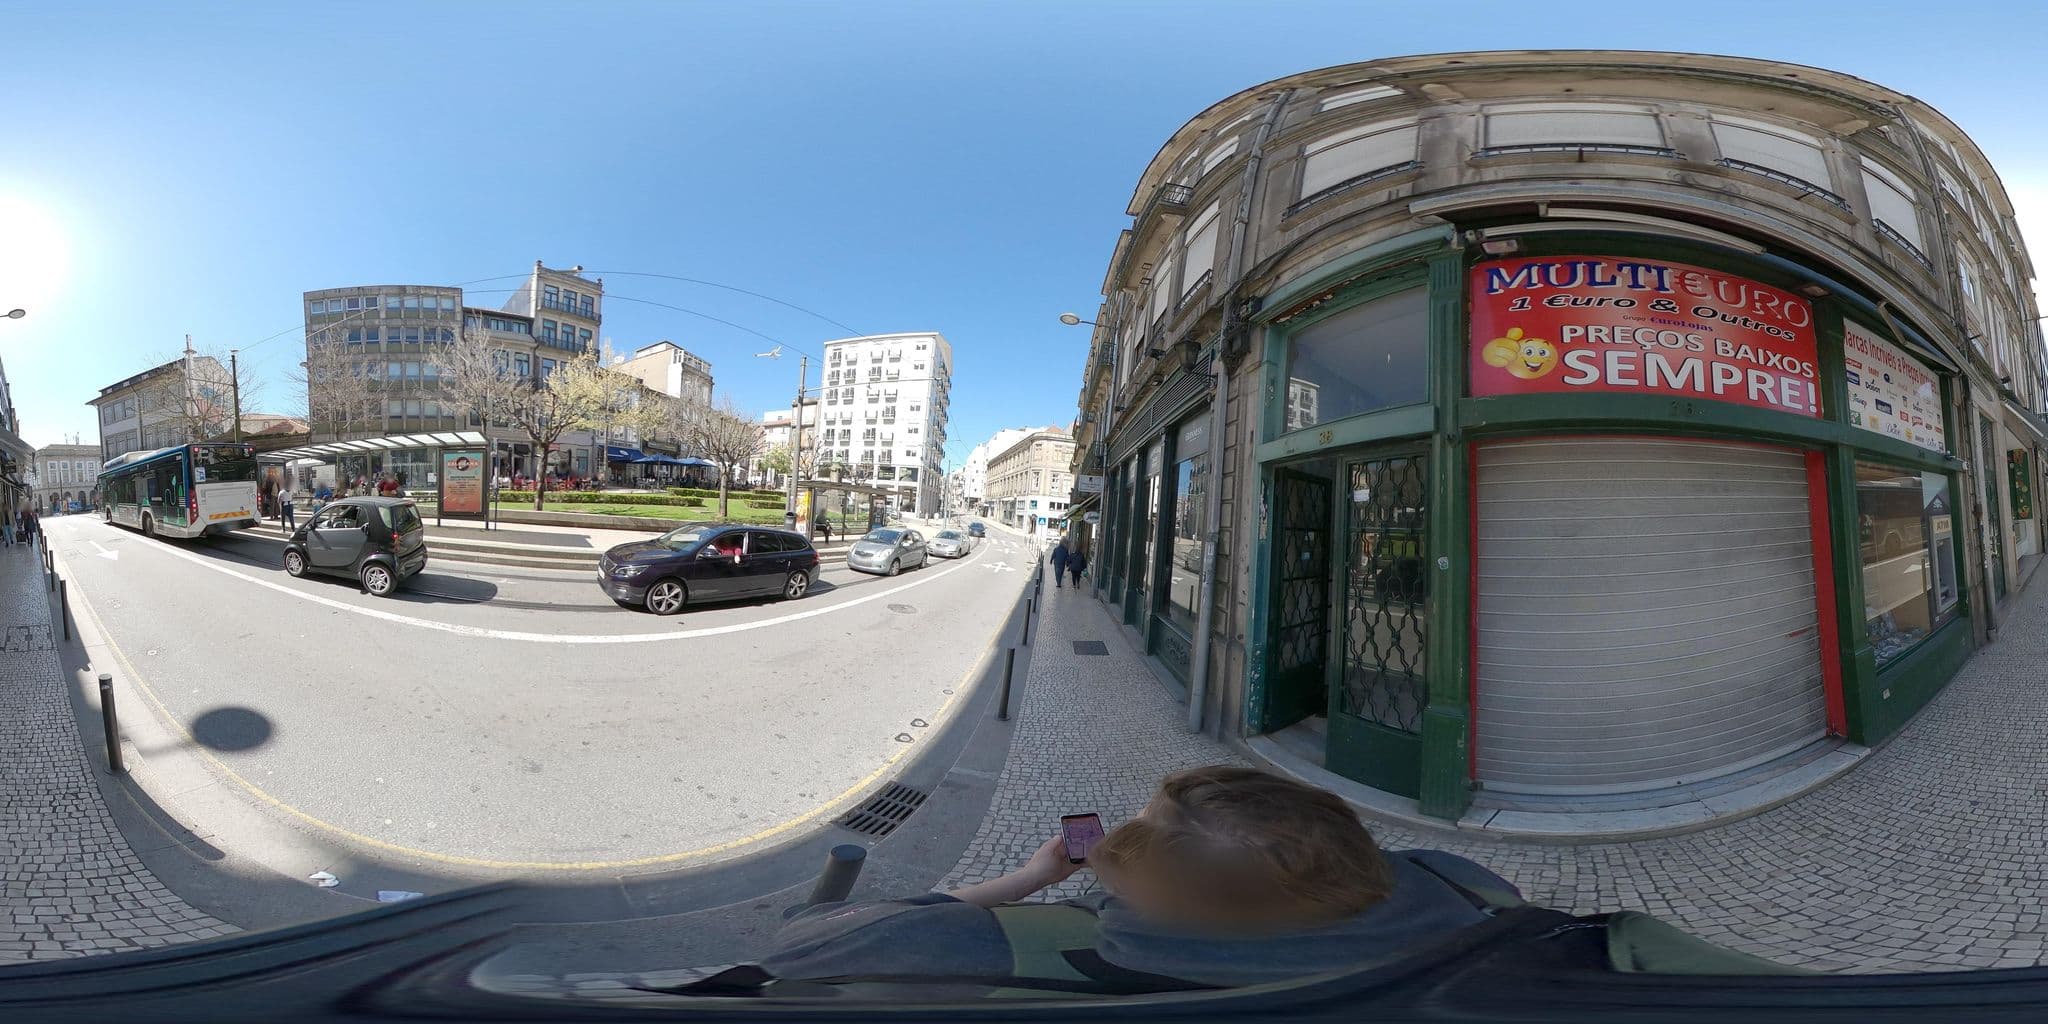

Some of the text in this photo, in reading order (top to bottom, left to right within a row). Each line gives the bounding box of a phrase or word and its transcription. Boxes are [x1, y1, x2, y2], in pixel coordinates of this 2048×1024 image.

[1509, 294, 1796, 341] 1 €uro & Outros
[1622, 314, 1647, 322] Grupo
[1561, 325, 1704, 352] PREÇOS
[1714, 338, 1815, 379] BAIXOS
[1562, 349, 1818, 414] SEMPRE!
